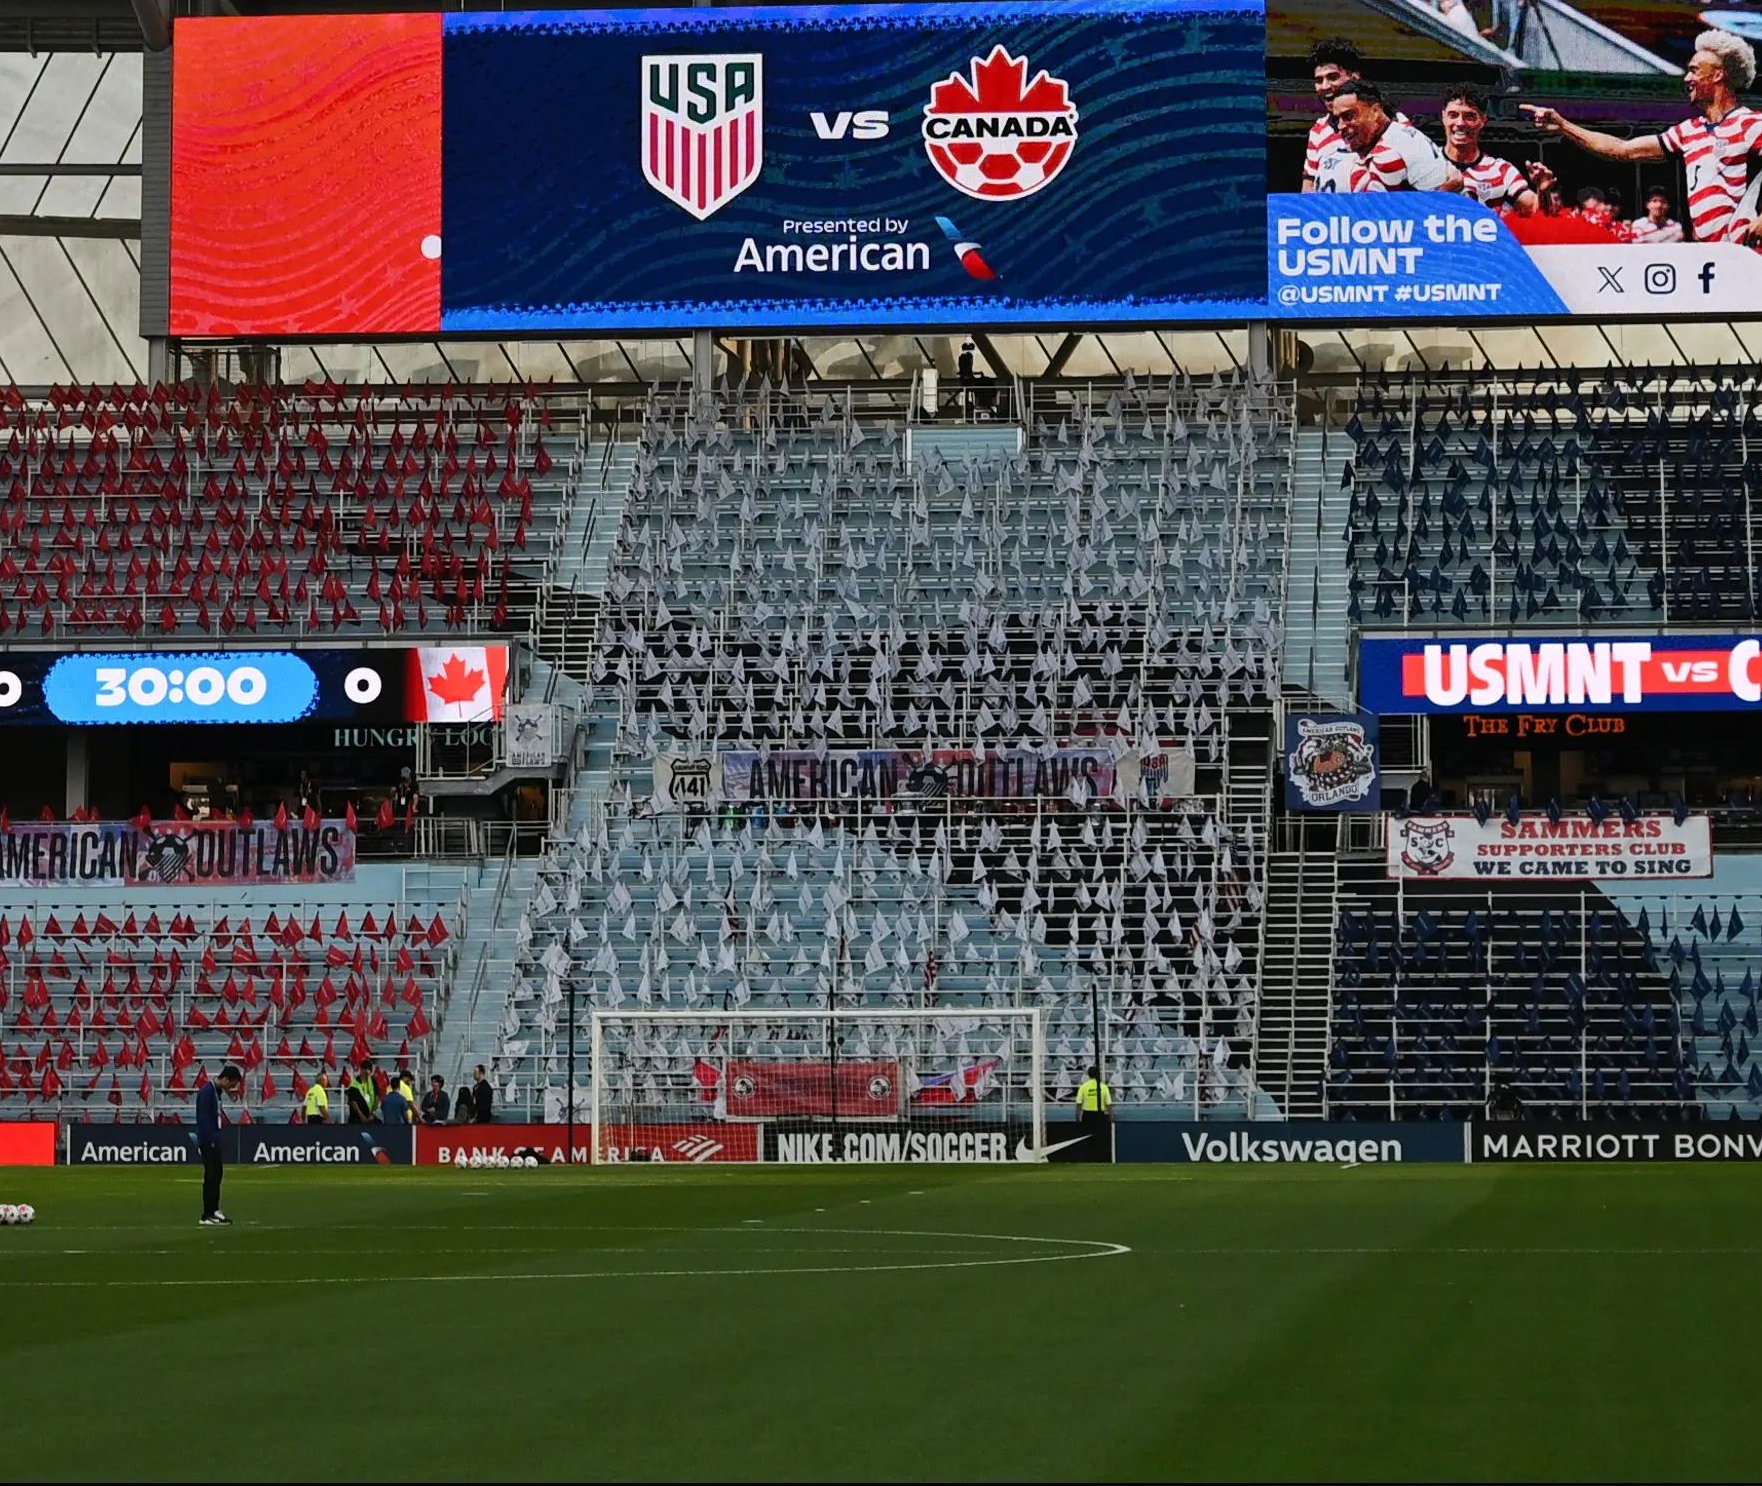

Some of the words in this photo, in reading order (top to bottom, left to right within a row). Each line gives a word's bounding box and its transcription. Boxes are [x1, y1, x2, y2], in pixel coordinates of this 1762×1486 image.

[649, 61, 755, 125] USA
[925, 116, 1072, 139] CANADA
[783, 218, 877, 235] Presented
[884, 217, 909, 237] by
[1278, 217, 1414, 246] Follow
[1424, 215, 1498, 243] the
[735, 237, 930, 274] American
[1278, 247, 1423, 277] USMNT
[1278, 285, 1388, 304] @USMNT
[1395, 283, 1501, 303] #USMNT
[96, 666, 267, 706] 30:00
[1424, 643, 1651, 706] USMNT
[334, 728, 436, 747] HUNGR
[749, 758, 899, 799] AMERICAN
[1311, 784, 1359, 802] ORLANDO
[1501, 819, 1662, 839] SAMMERS
[195, 826, 340, 879] OUTLAWS
[1477, 843, 1625, 857] SUPPORTERS
[1629, 842, 1686, 856] CLUB
[1473, 861, 1512, 875] WE
[1519, 861, 1589, 875] CAME
[1596, 860, 1627, 874] TO
[1634, 859, 1691, 874] SING
[81, 1141, 187, 1163] American
[253, 1141, 360, 1163] American
[439, 1146, 506, 1163] BANK
[777, 1130, 1007, 1162] NIKE.COM/SOCCER
[1181, 1131, 1402, 1164] Volkswagen
[1483, 1134, 1660, 1159] MARRIOTT
